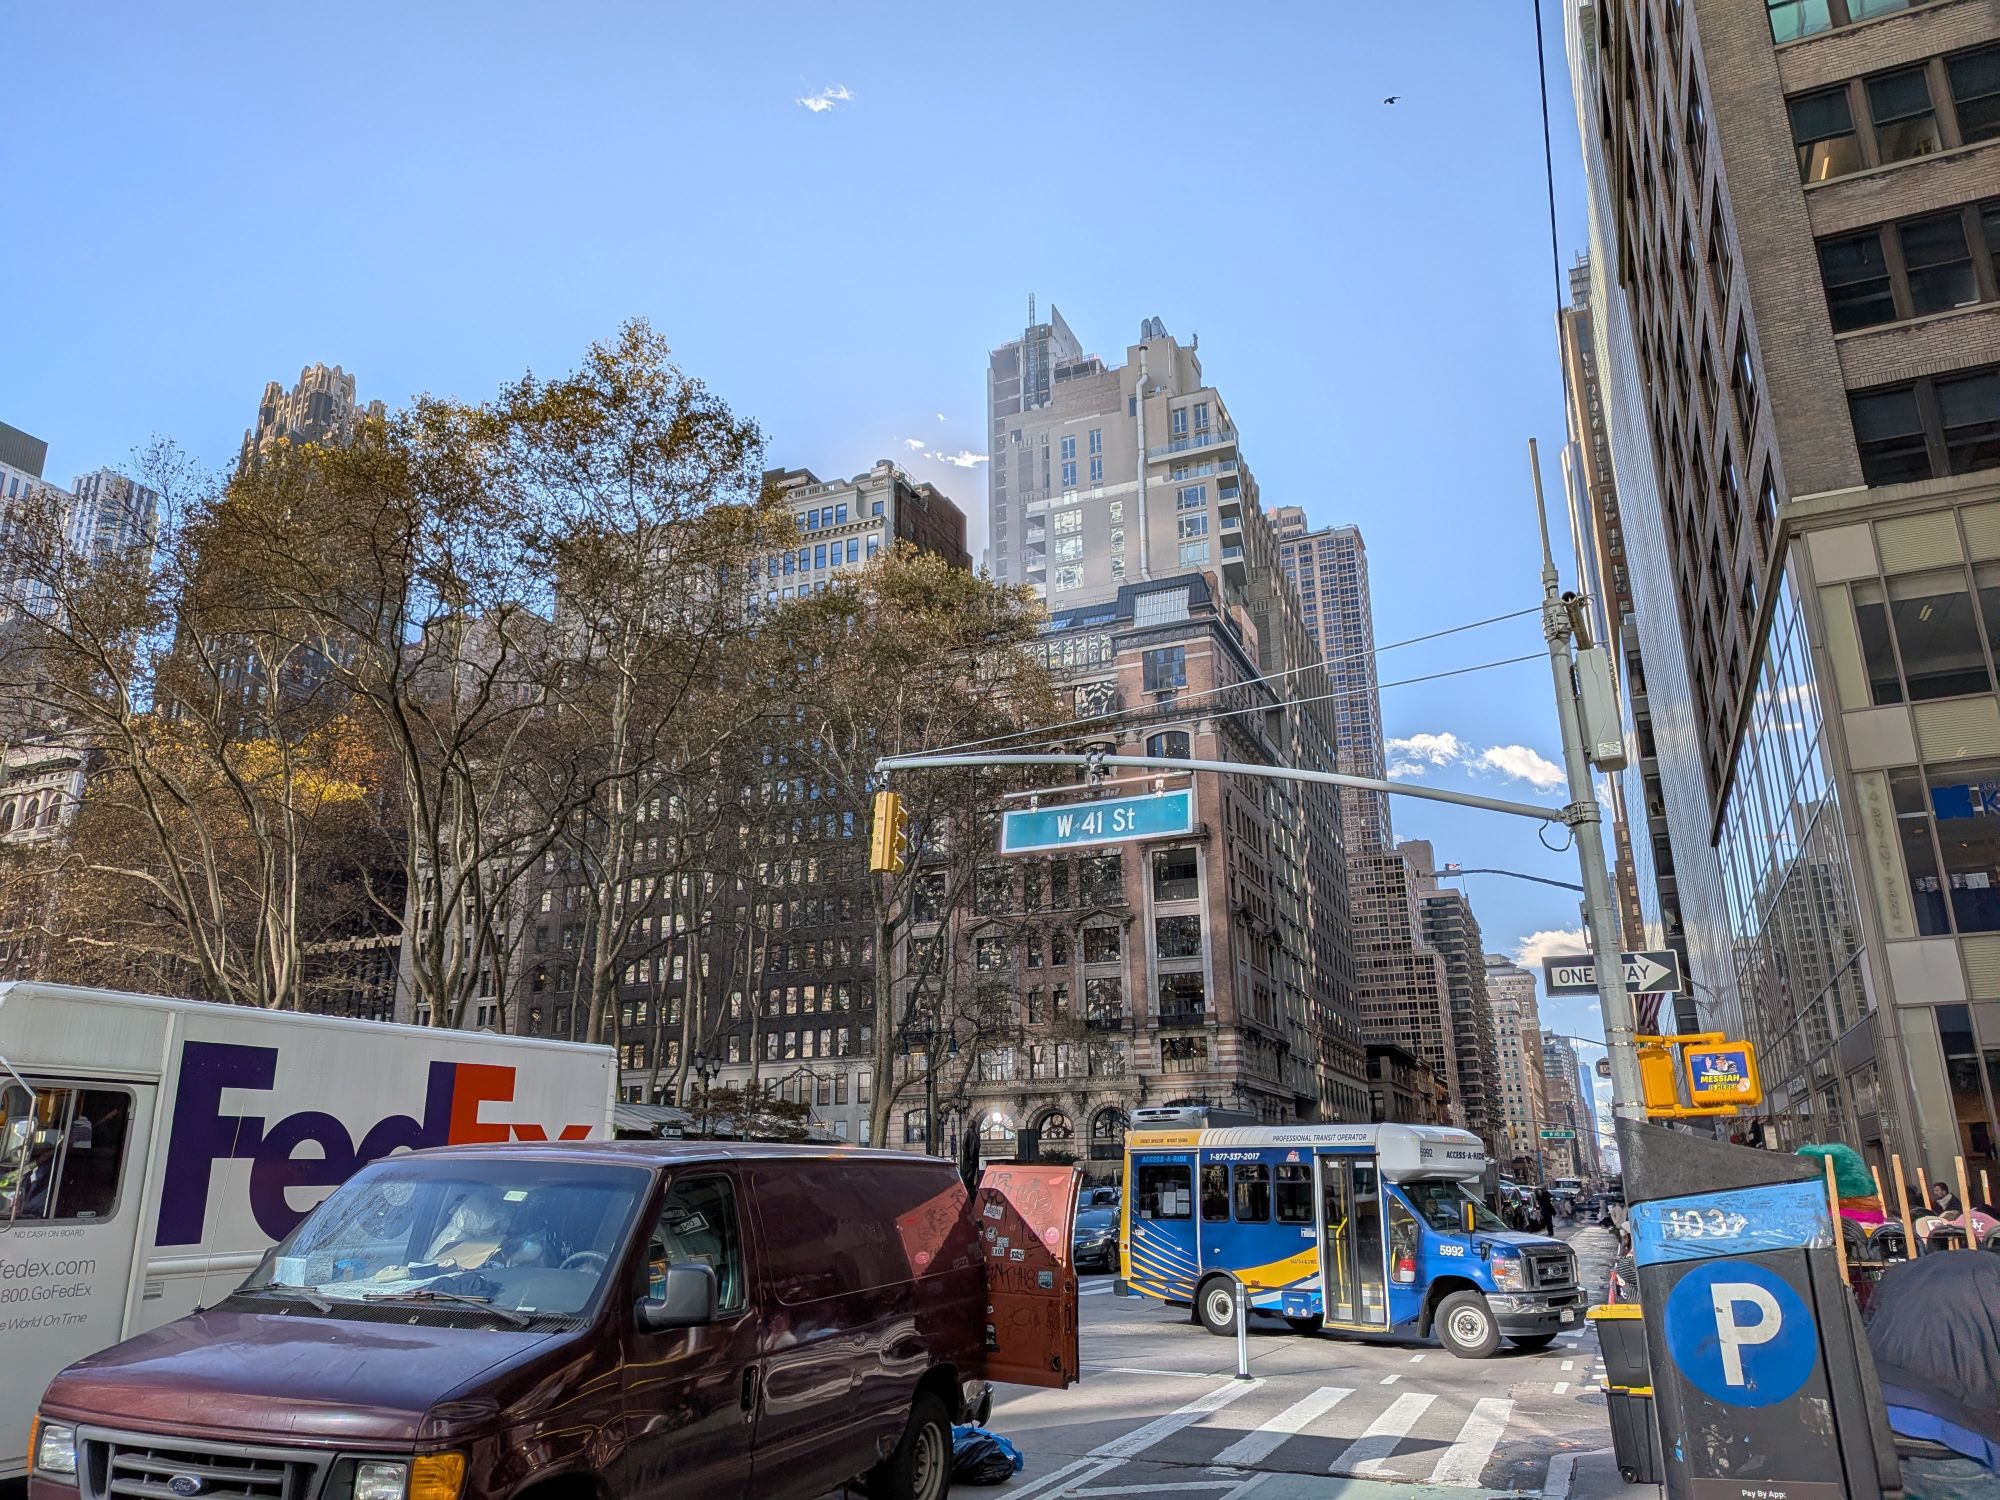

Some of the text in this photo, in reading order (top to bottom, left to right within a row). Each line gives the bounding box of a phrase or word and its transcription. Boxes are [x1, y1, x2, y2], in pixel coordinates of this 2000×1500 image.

[1057, 807, 1136, 838] W 41 St
[1559, 964, 1650, 984] ONE AY
[1700, 1074, 1740, 1083] MESSIAH
[1272, 1134, 1311, 1142] PROFESSIONAL
[1337, 1133, 1367, 1141] OPERATOR
[1141, 1155, 1188, 1163] ACCESS-A-RIDE
[1209, 1153, 1260, 1161] 1-877-337-2017
[1446, 1150, 1485, 1161] ACCESS-A-RIDE
[60, 1229, 85, 1237] BOARD
[1440, 1245, 1464, 1257] 5992
[8, 1317, 42, 1330] World
[43, 1314, 60, 1327] On
[61, 1313, 88, 1324] Time
[1710, 1282, 1782, 1387] P
[1741, 1489, 1786, 1499] Pay By App:
